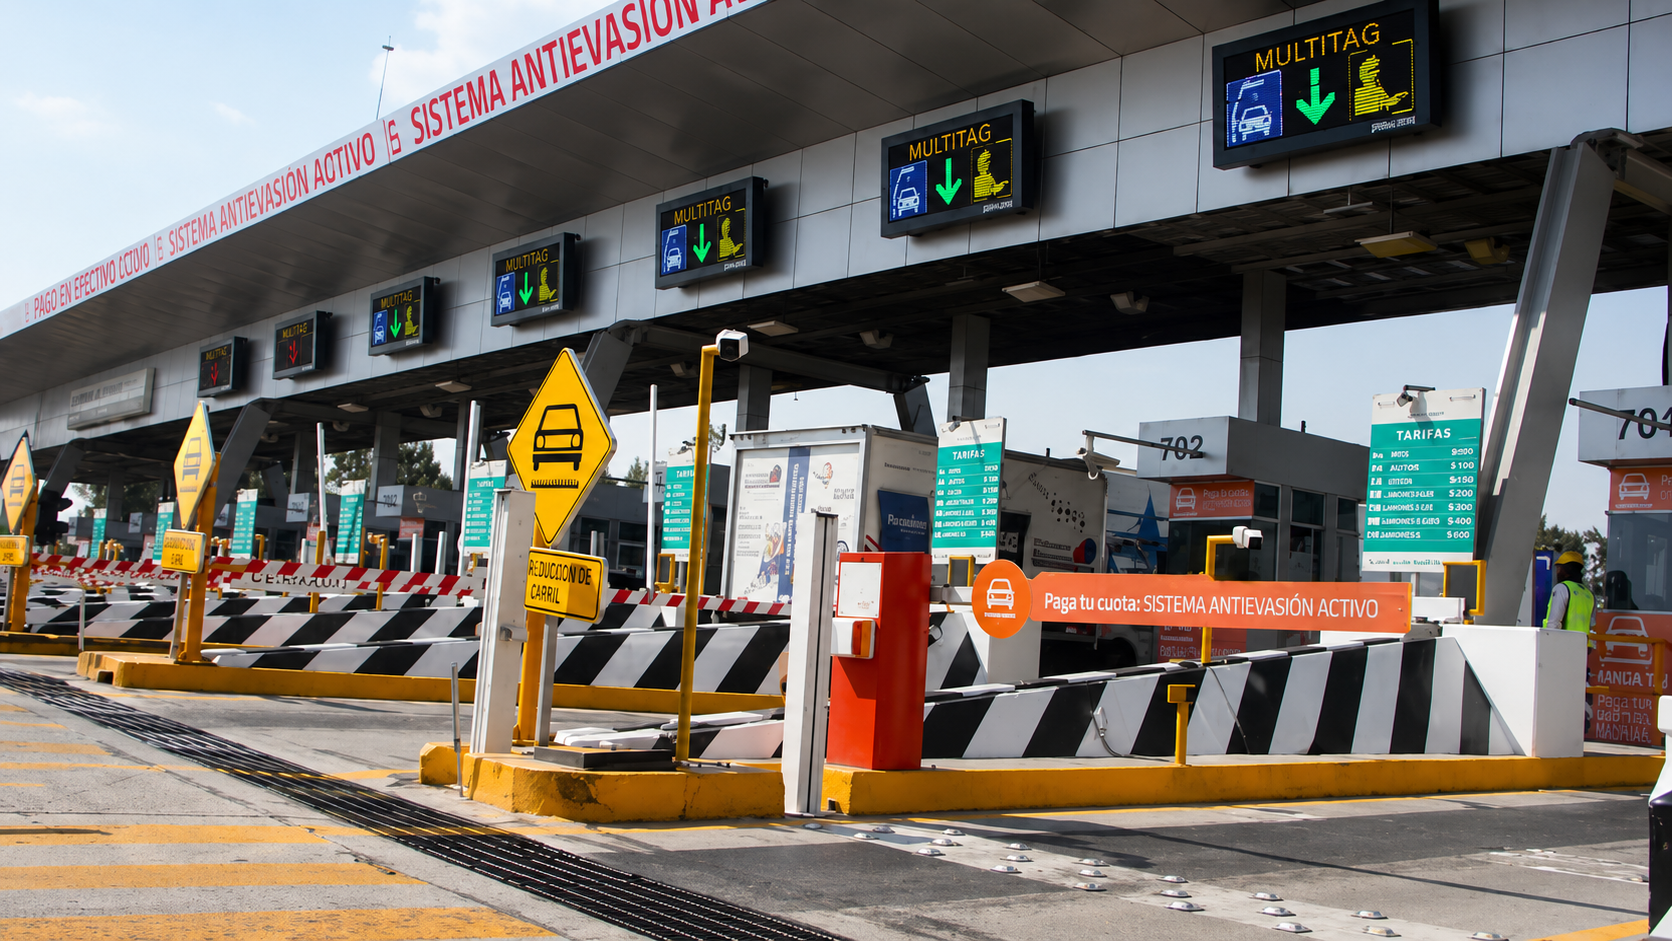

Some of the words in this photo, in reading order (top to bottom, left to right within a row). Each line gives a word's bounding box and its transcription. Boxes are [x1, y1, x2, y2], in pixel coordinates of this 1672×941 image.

[1255, 23, 1380, 72] MULTITAG
[410, 69, 507, 145] SISTEMA
[909, 123, 991, 161] MULTITAG
[168, 211, 217, 256] SISTEMA
[220, 165, 309, 233] ANTIEVASIÓN
[674, 196, 731, 225] MULTITAG
[505, 248, 549, 272] MULTITAG
[34, 289, 57, 319] PAGO
[60, 281, 72, 307] EN
[74, 259, 116, 300] EFECTIVO
[380, 290, 413, 310] MULTITAG
[1160, 434, 1204, 461] 702
[1396, 428, 1452, 441] TARIFAS
[952, 449, 986, 461] TARIFAS
[578, 567, 592, 585] DE
[530, 583, 560, 604] CARRIL
[1045, 592, 1077, 614] Paga
[1080, 594, 1095, 610] tu
[1097, 594, 1141, 611] cuota:
[1143, 595, 1206, 614] SISTEMA
[1208, 593, 1314, 617] ANTIEVASIÓN
[1317, 598, 1379, 618] ACTIVO
